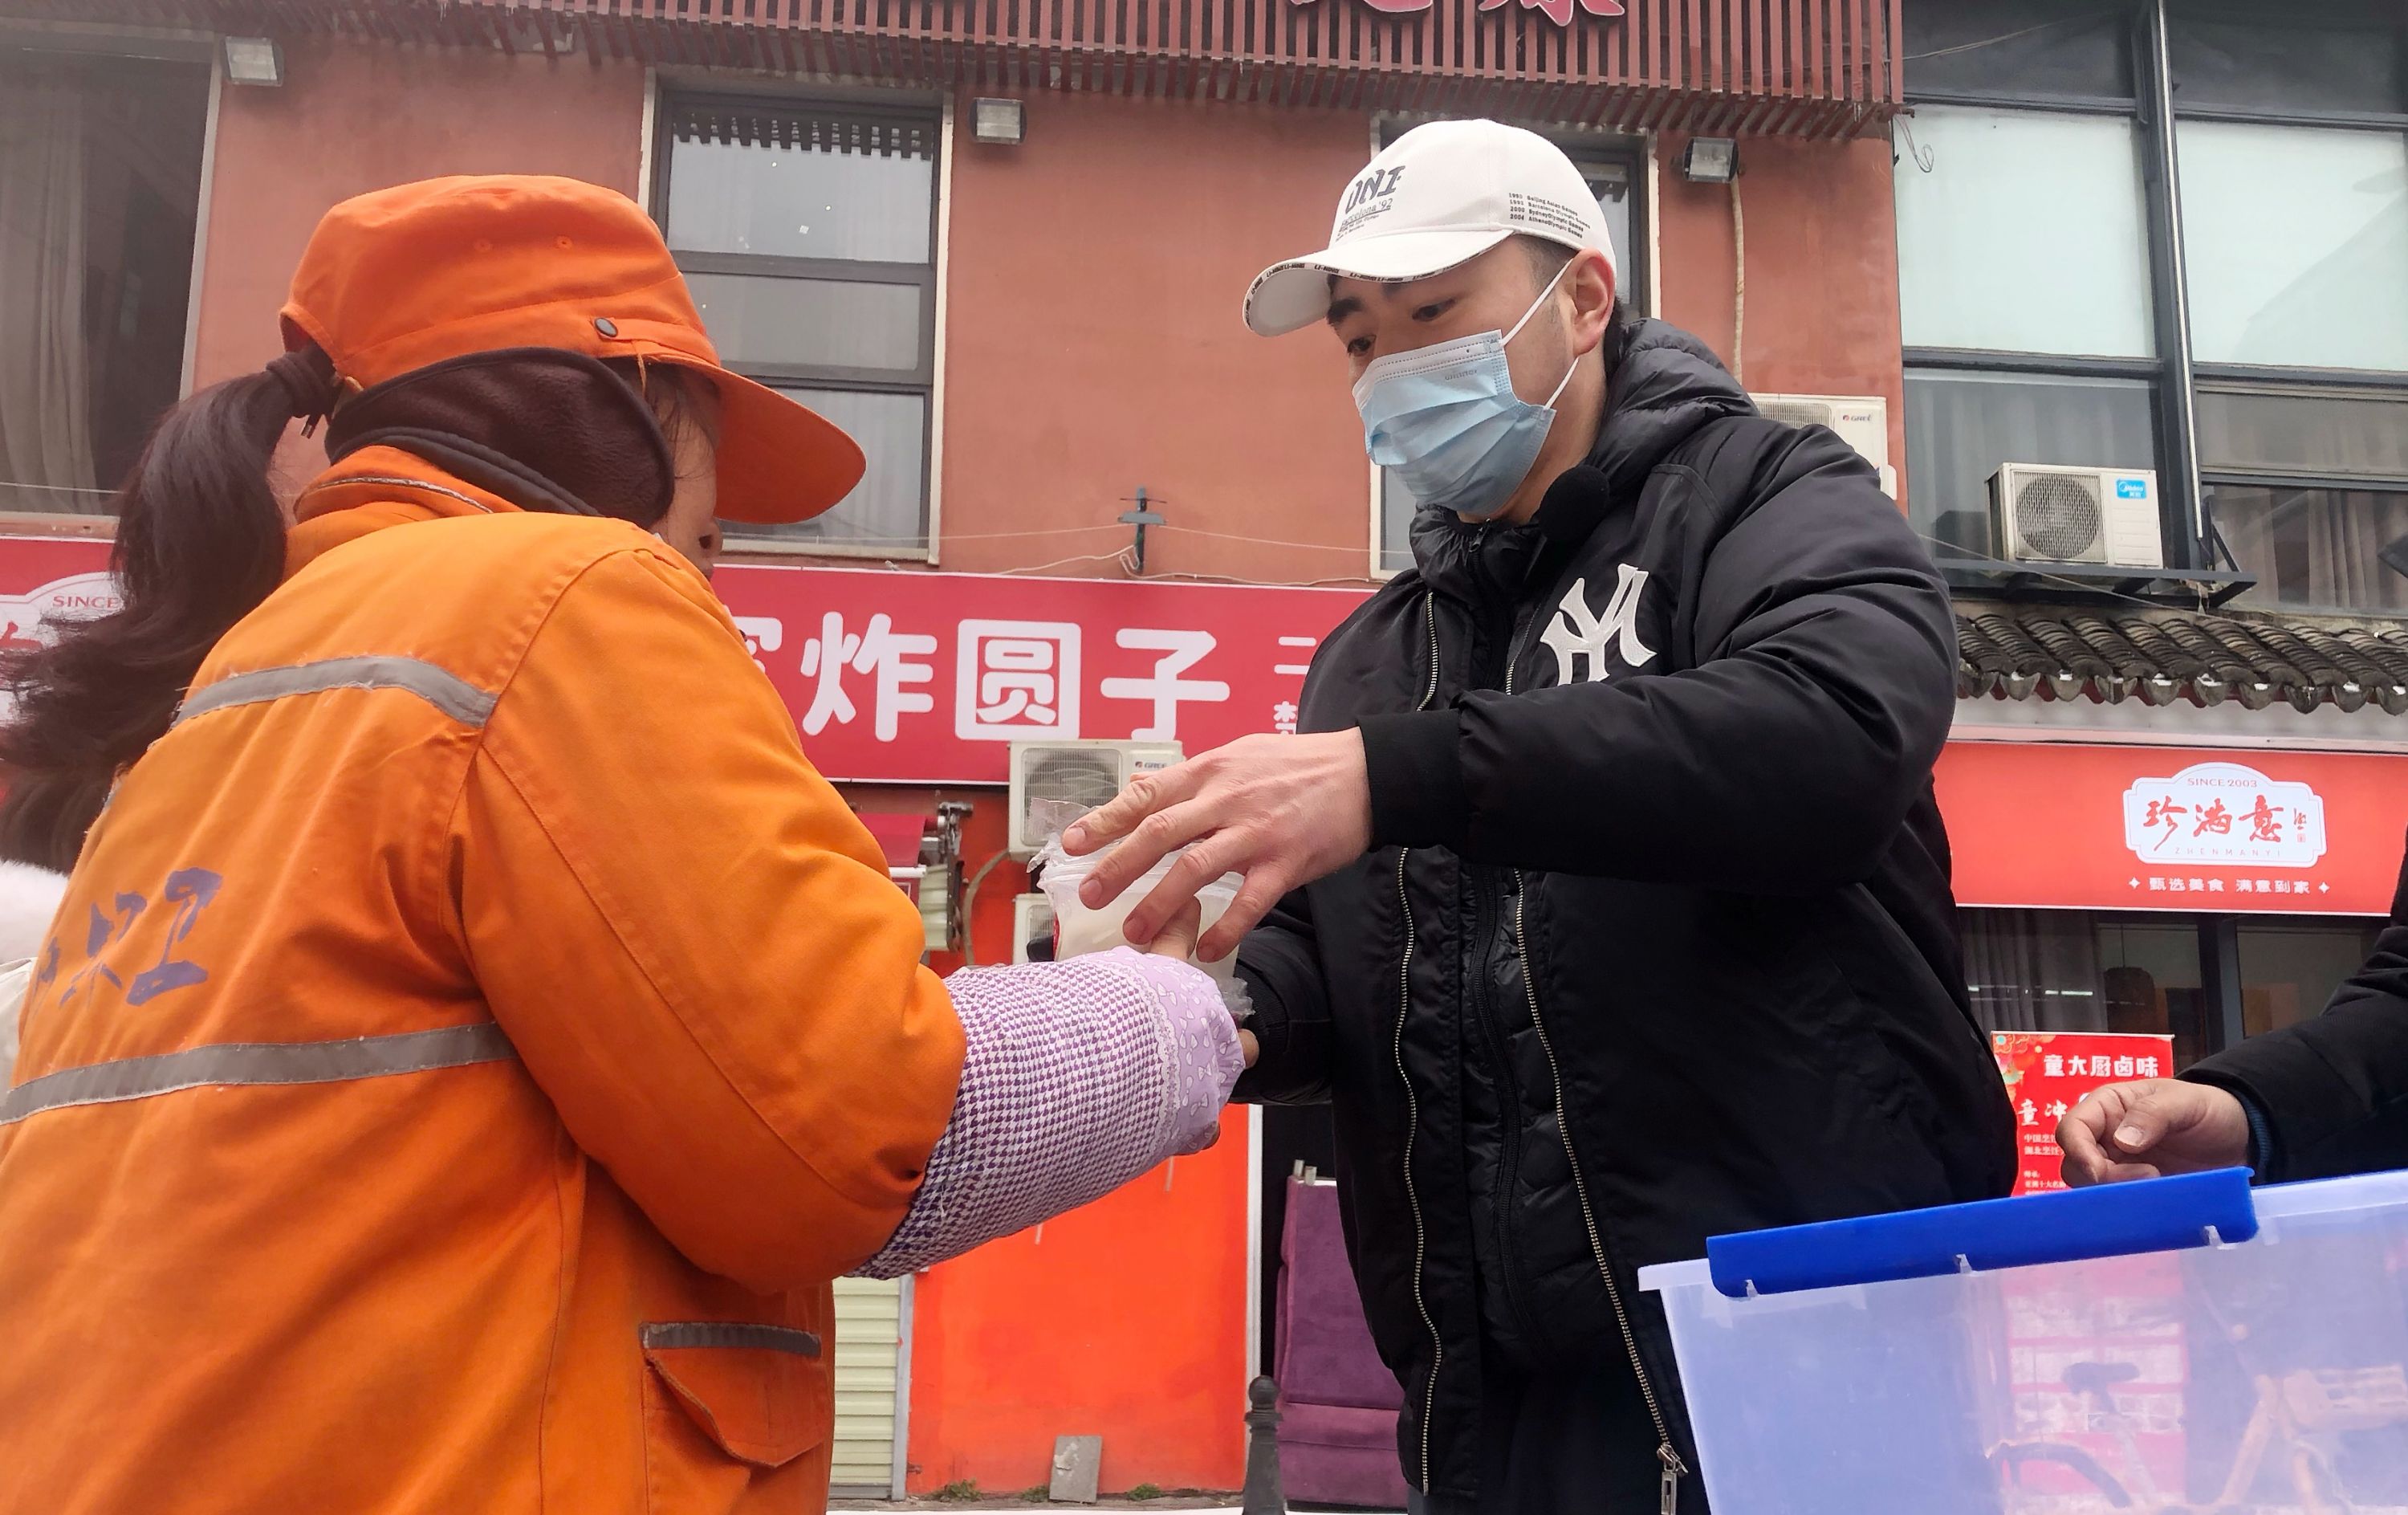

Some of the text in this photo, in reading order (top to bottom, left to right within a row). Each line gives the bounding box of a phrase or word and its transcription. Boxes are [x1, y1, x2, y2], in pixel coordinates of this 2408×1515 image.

[2187, 778, 2257, 788] SINCE 2003
[2149, 878, 2310, 894] 甄选美食 满意到家
[2044, 1054, 2158, 1077] 童大厨卤味
